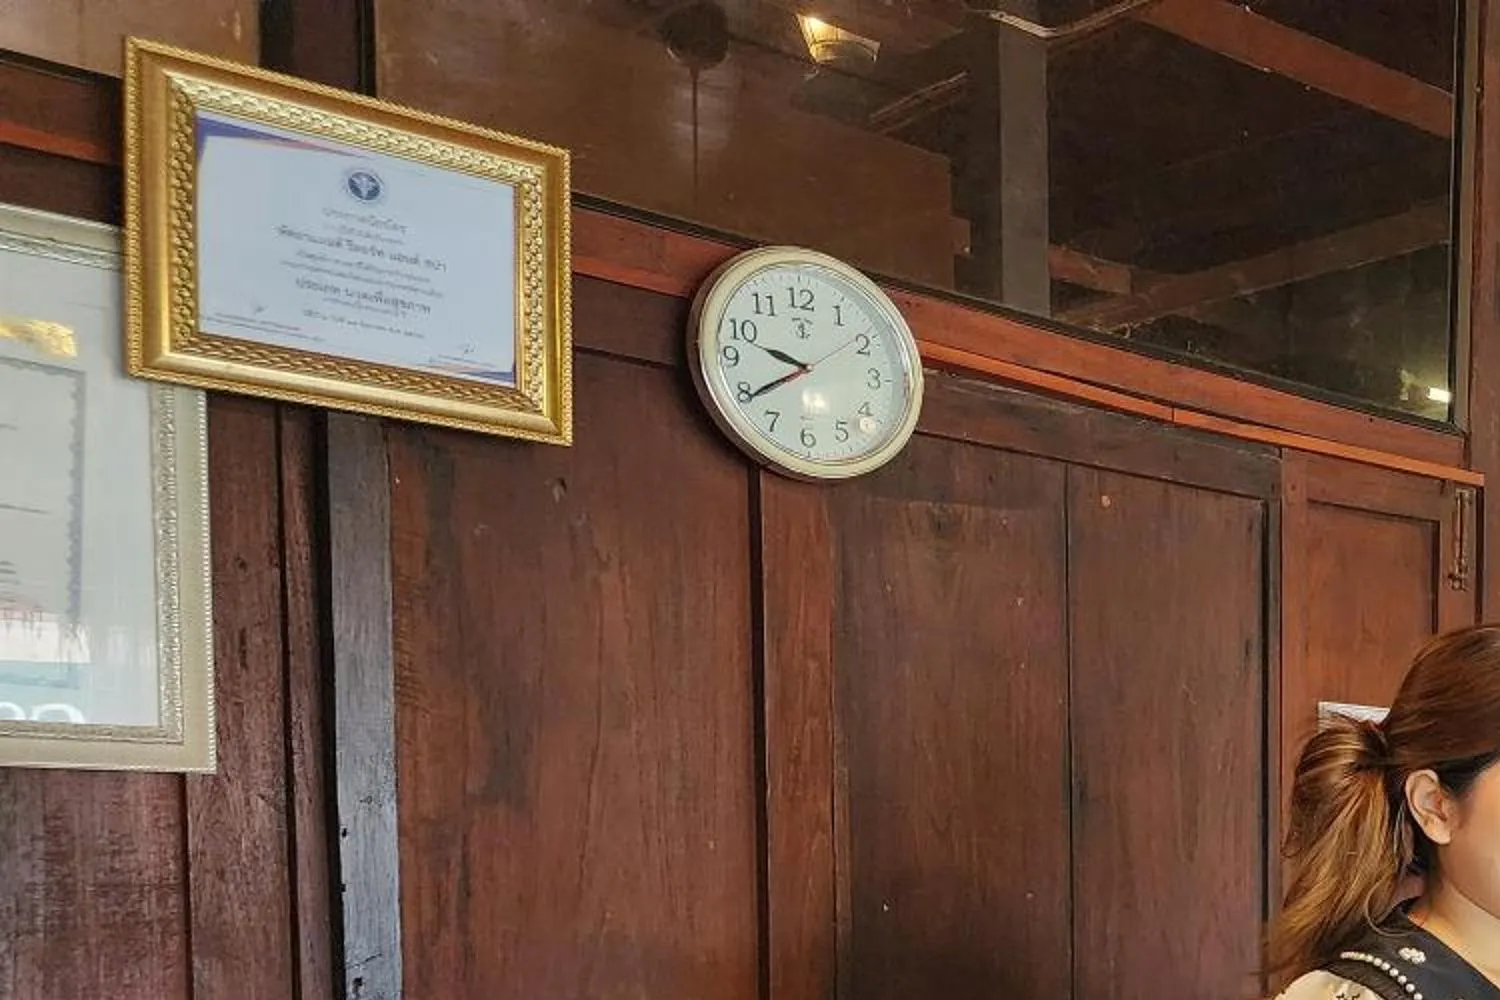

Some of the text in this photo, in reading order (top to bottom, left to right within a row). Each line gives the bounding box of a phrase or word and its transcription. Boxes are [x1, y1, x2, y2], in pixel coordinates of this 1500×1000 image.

[752, 293, 777, 317] 11
[786, 287, 815, 312] 12
[832, 305, 845, 327] 1
[730, 318, 757, 343] 10
[855, 333, 870, 356] 2
[723, 345, 739, 367] 9
[867, 368, 881, 390] 3
[737, 381, 751, 403] 8
[857, 401, 874, 417] 4
[764, 410, 781, 433] 7
[835, 421, 849, 443] 5
[800, 427, 816, 448] 6
